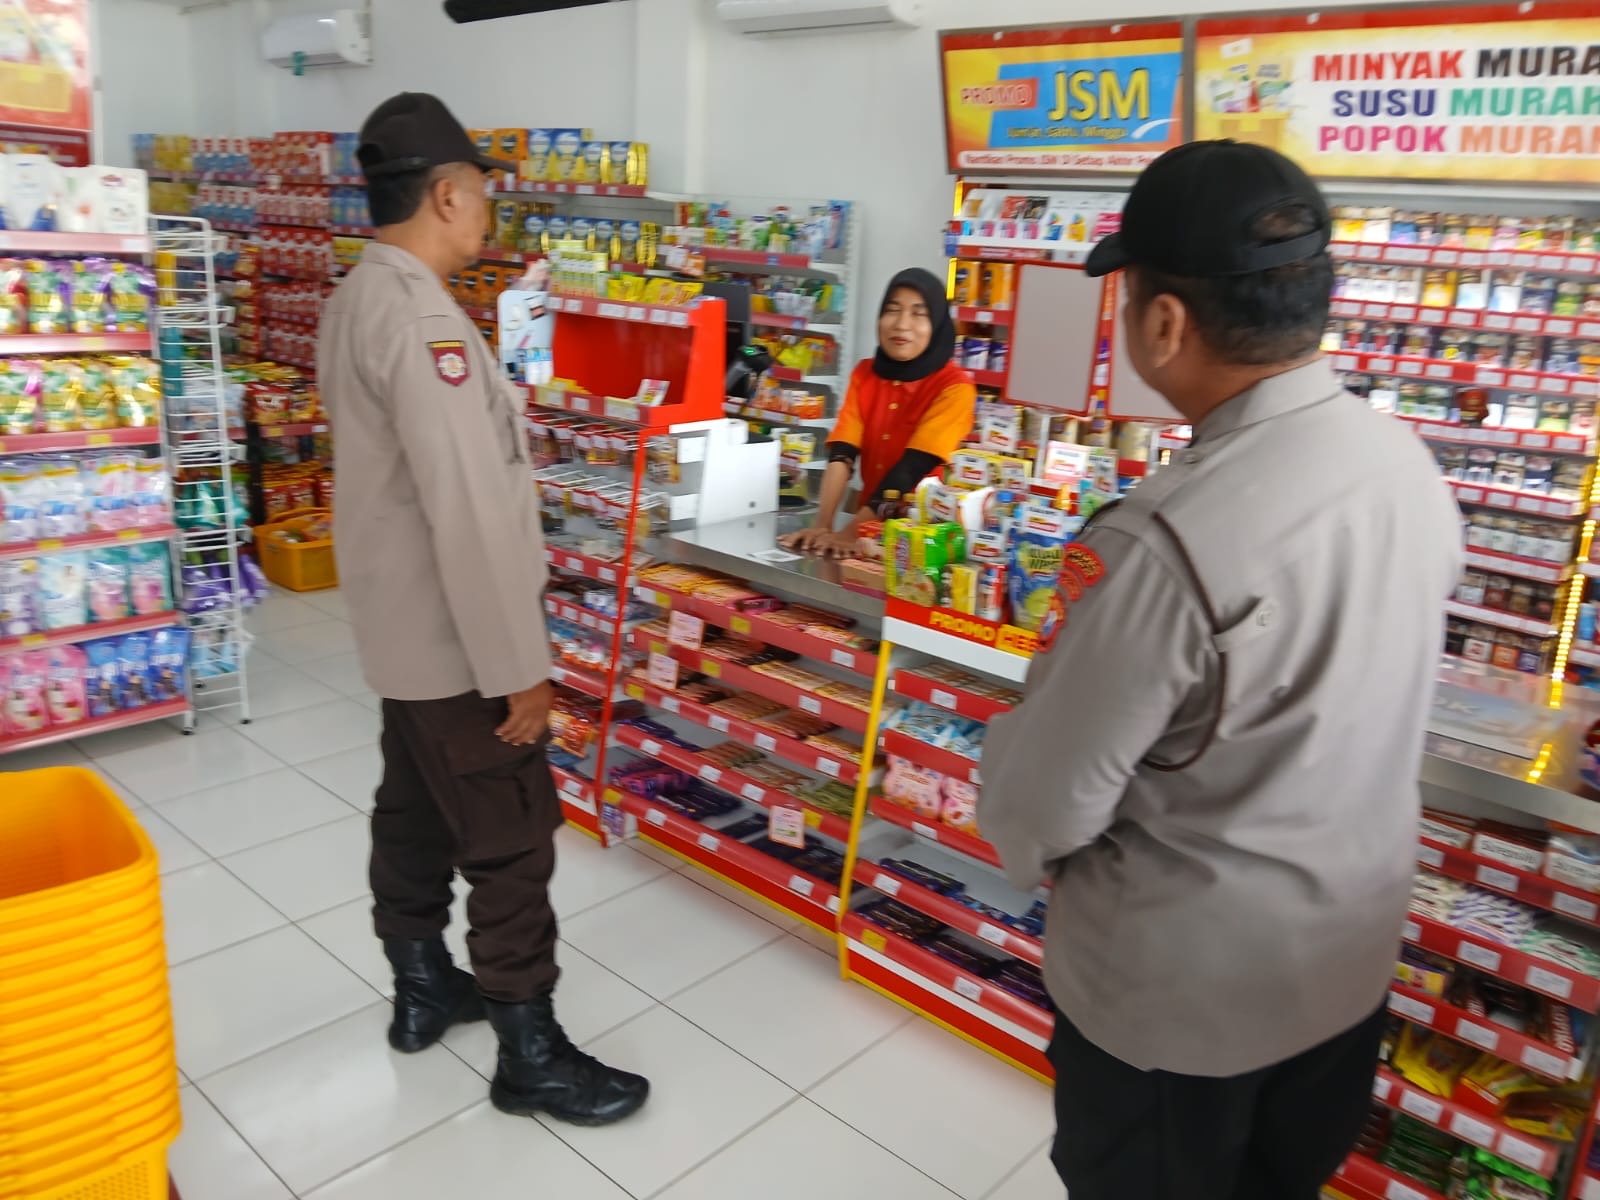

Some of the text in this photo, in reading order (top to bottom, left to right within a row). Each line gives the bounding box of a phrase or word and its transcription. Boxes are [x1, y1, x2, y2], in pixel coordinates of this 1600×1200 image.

[1312, 50, 1465, 82] MINYAK
[960, 84, 1033, 107] PROMO
[1048, 67, 1150, 121] JSM
[1333, 89, 1437, 117] SUSU
[1319, 124, 1447, 152] POPOK
[929, 611, 996, 642] PROMO
